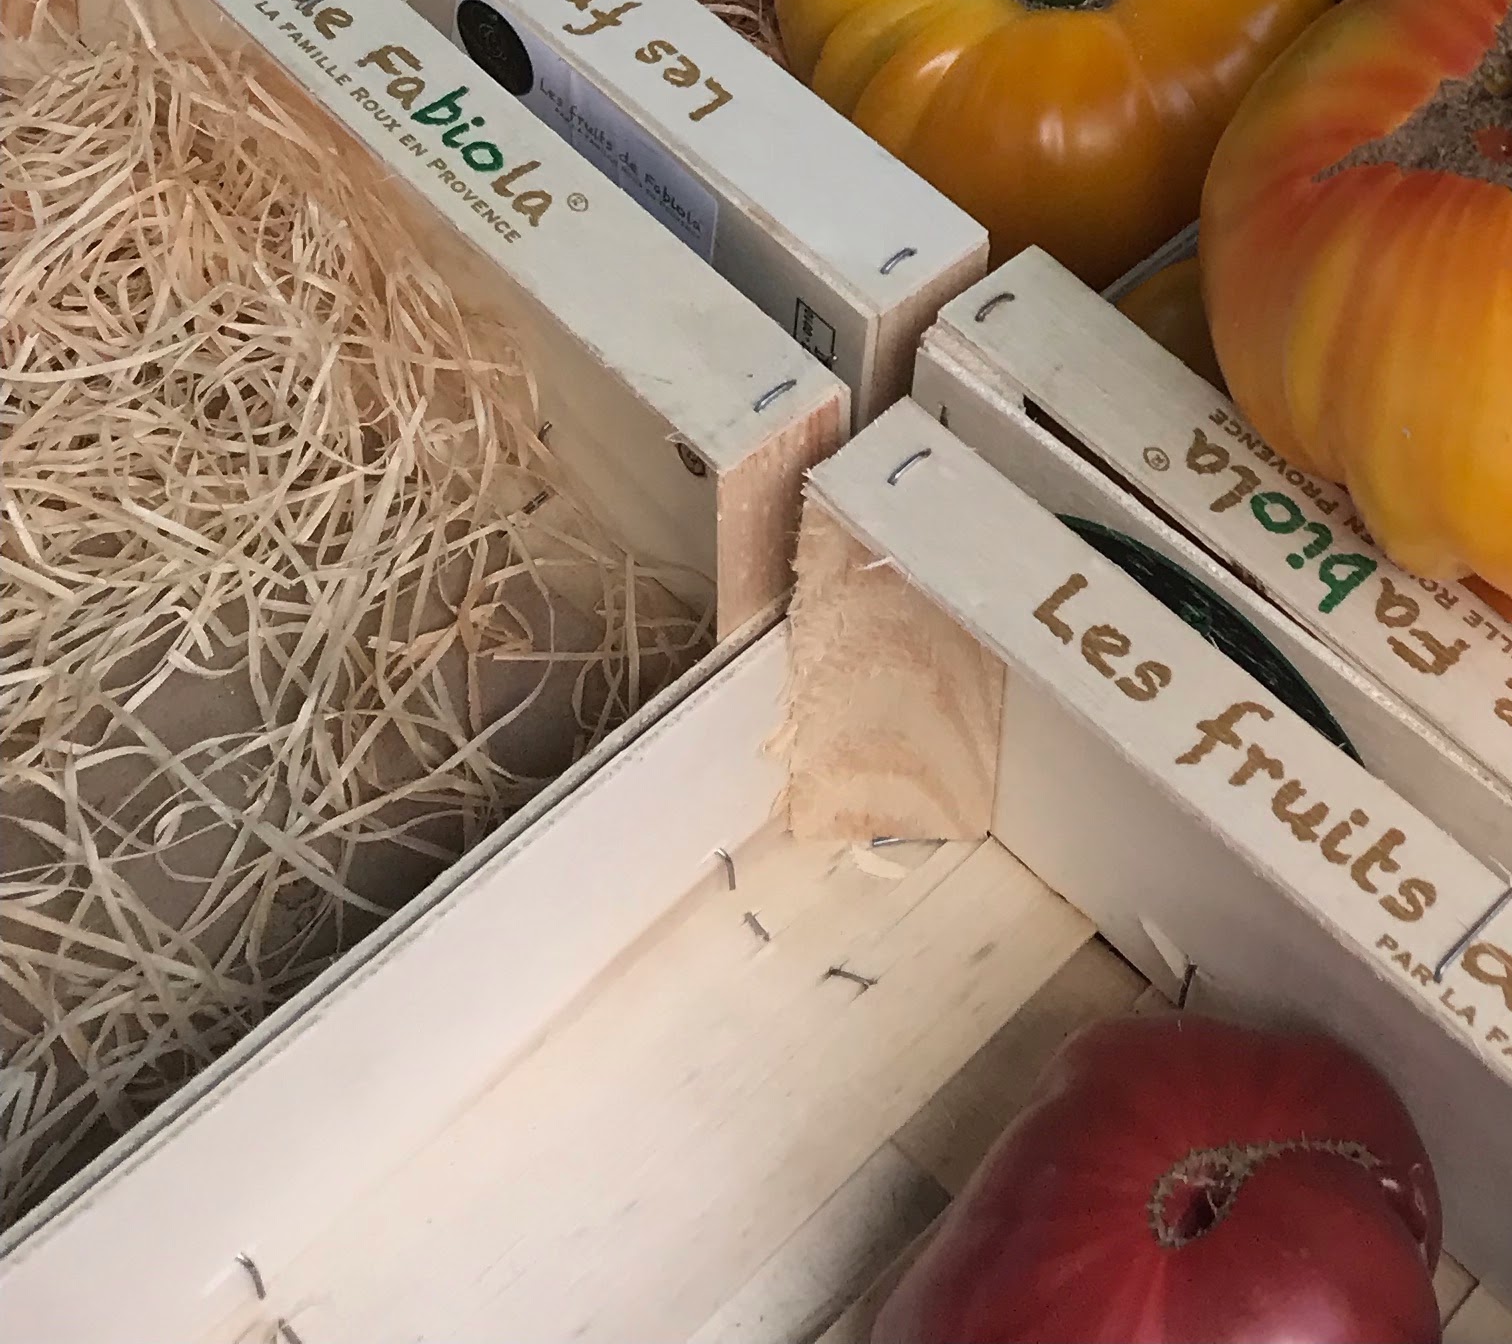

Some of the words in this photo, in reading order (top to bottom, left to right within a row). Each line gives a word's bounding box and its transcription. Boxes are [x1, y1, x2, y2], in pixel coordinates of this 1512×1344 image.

[255, 0, 280, 22] LA
[277, 21, 353, 87] FAMILLE
[349, 86, 402, 134] ROUX
[398, 133, 429, 158] EN
[426, 157, 523, 245] PROVENCE
[355, 43, 553, 228] Fabiola
[634, 39, 734, 123] Les
[1207, 408, 1340, 516] PROVENCE
[1185, 427, 1472, 677] Fabiola
[1408, 573, 1460, 611] RO
[1032, 572, 1173, 701] Les
[1174, 700, 1438, 923] fruits
[1375, 933, 1434, 987] PAR
[1438, 987, 1477, 1028] LA
